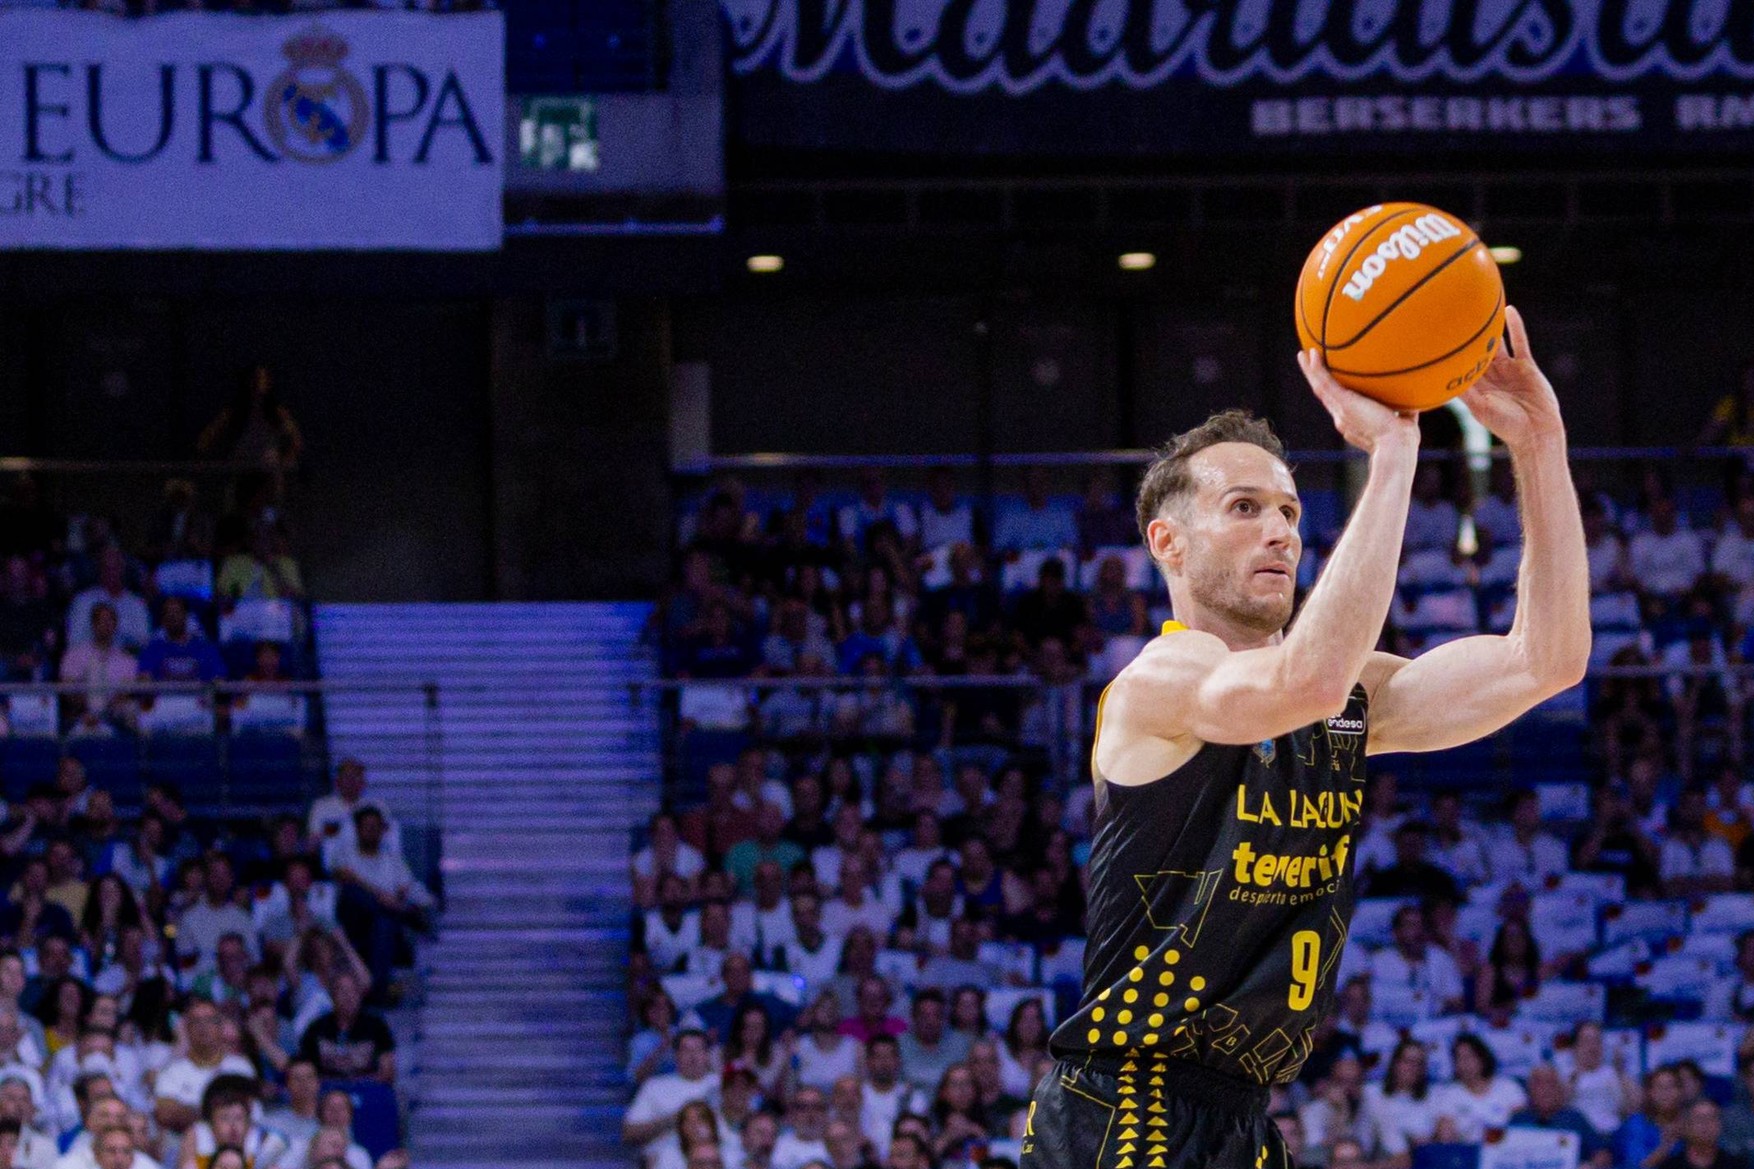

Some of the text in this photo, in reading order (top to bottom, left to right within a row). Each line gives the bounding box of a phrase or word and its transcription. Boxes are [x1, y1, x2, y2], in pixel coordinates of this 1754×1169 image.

[1251, 95, 1640, 134] BERSERKERS
[1341, 213, 1462, 303] Wilson
[1327, 718, 1363, 729] endesa
[1236, 784, 1283, 827] LA
[1287, 929, 1322, 1012] 9
